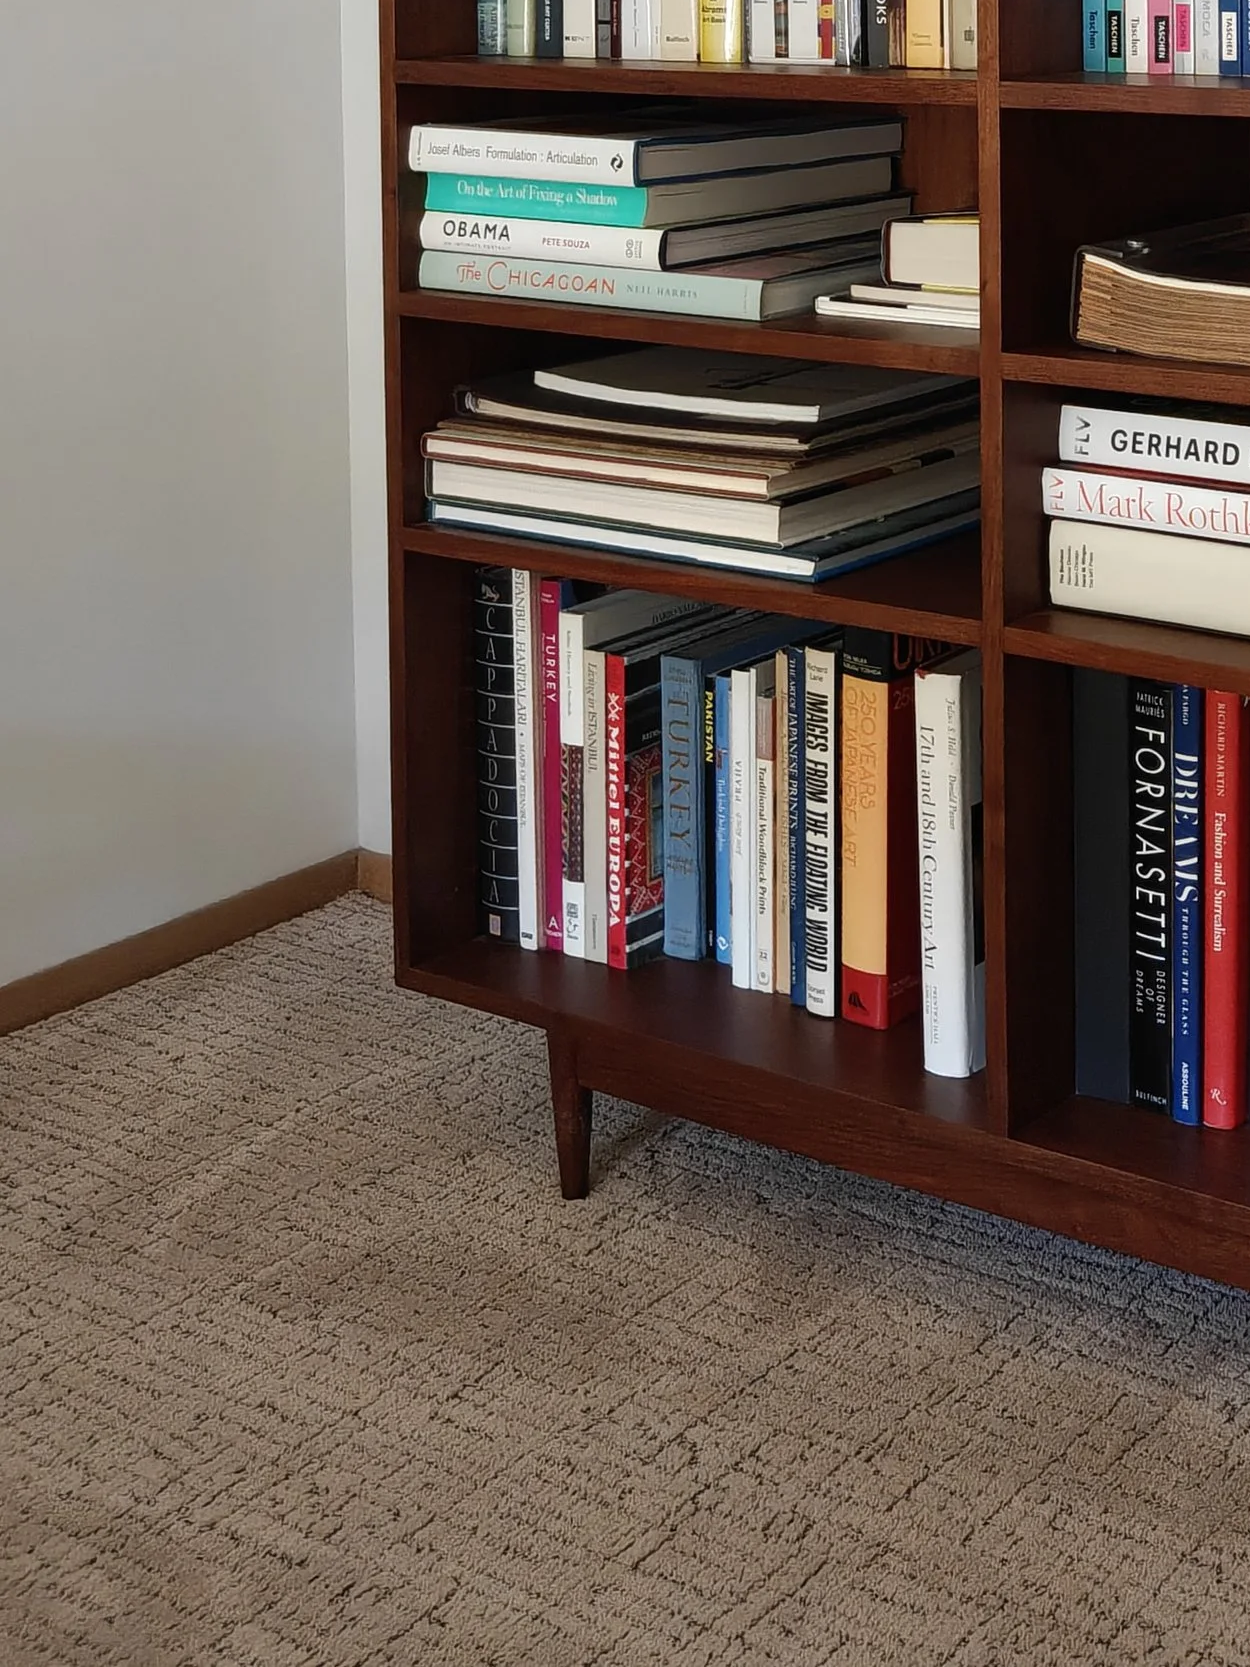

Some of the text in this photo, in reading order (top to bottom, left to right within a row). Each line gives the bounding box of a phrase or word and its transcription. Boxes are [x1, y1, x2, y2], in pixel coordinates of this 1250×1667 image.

[1089, 11, 1098, 49] Taschen
[1111, 16, 1119, 53] TASCHEN
[1131, 17, 1141, 56] Taschen
[1158, 20, 1166, 59] TASCHEN
[427, 141, 598, 167] Josef Albers Formulation Articulation
[457, 180, 494, 197] On the
[443, 219, 590, 250] OBAMA PETE SOUZA
[456, 261, 616, 294] The CHICAGOAN
[1111, 429, 1241, 466] GERHARD
[1075, 479, 1155, 524] Mark
[546, 634, 556, 702] TURKEY
[587, 698, 596, 710] in
[705, 691, 713, 762] PAKISTAN
[668, 693, 691, 849] TURKEY
[859, 692, 875, 809] 250 YEARS
[844, 721, 858, 866] JAPANESE ART
[610, 725, 620, 927] Mittel EUROPA
[758, 766, 767, 914] Traditional Woodblock Prints
[806, 693, 828, 973] IMAGES FROM THE FLOATING WORLD
[920, 725, 938, 971] 17th and 18th Century Art
[1135, 726, 1165, 961] FORNASETTI
[1174, 752, 1198, 902] DREAMS
[1214, 703, 1226, 951] RICHARD MARTIN Fashion and Surrealism
[1181, 908, 1189, 964] THROUGH
[1135, 970, 1144, 1013] DREAMS
[1145, 989, 1154, 1001] OF
[1156, 970, 1165, 1024] DESIGNER
[1181, 970, 1189, 994] THE
[1181, 999, 1189, 1036] GLASS
